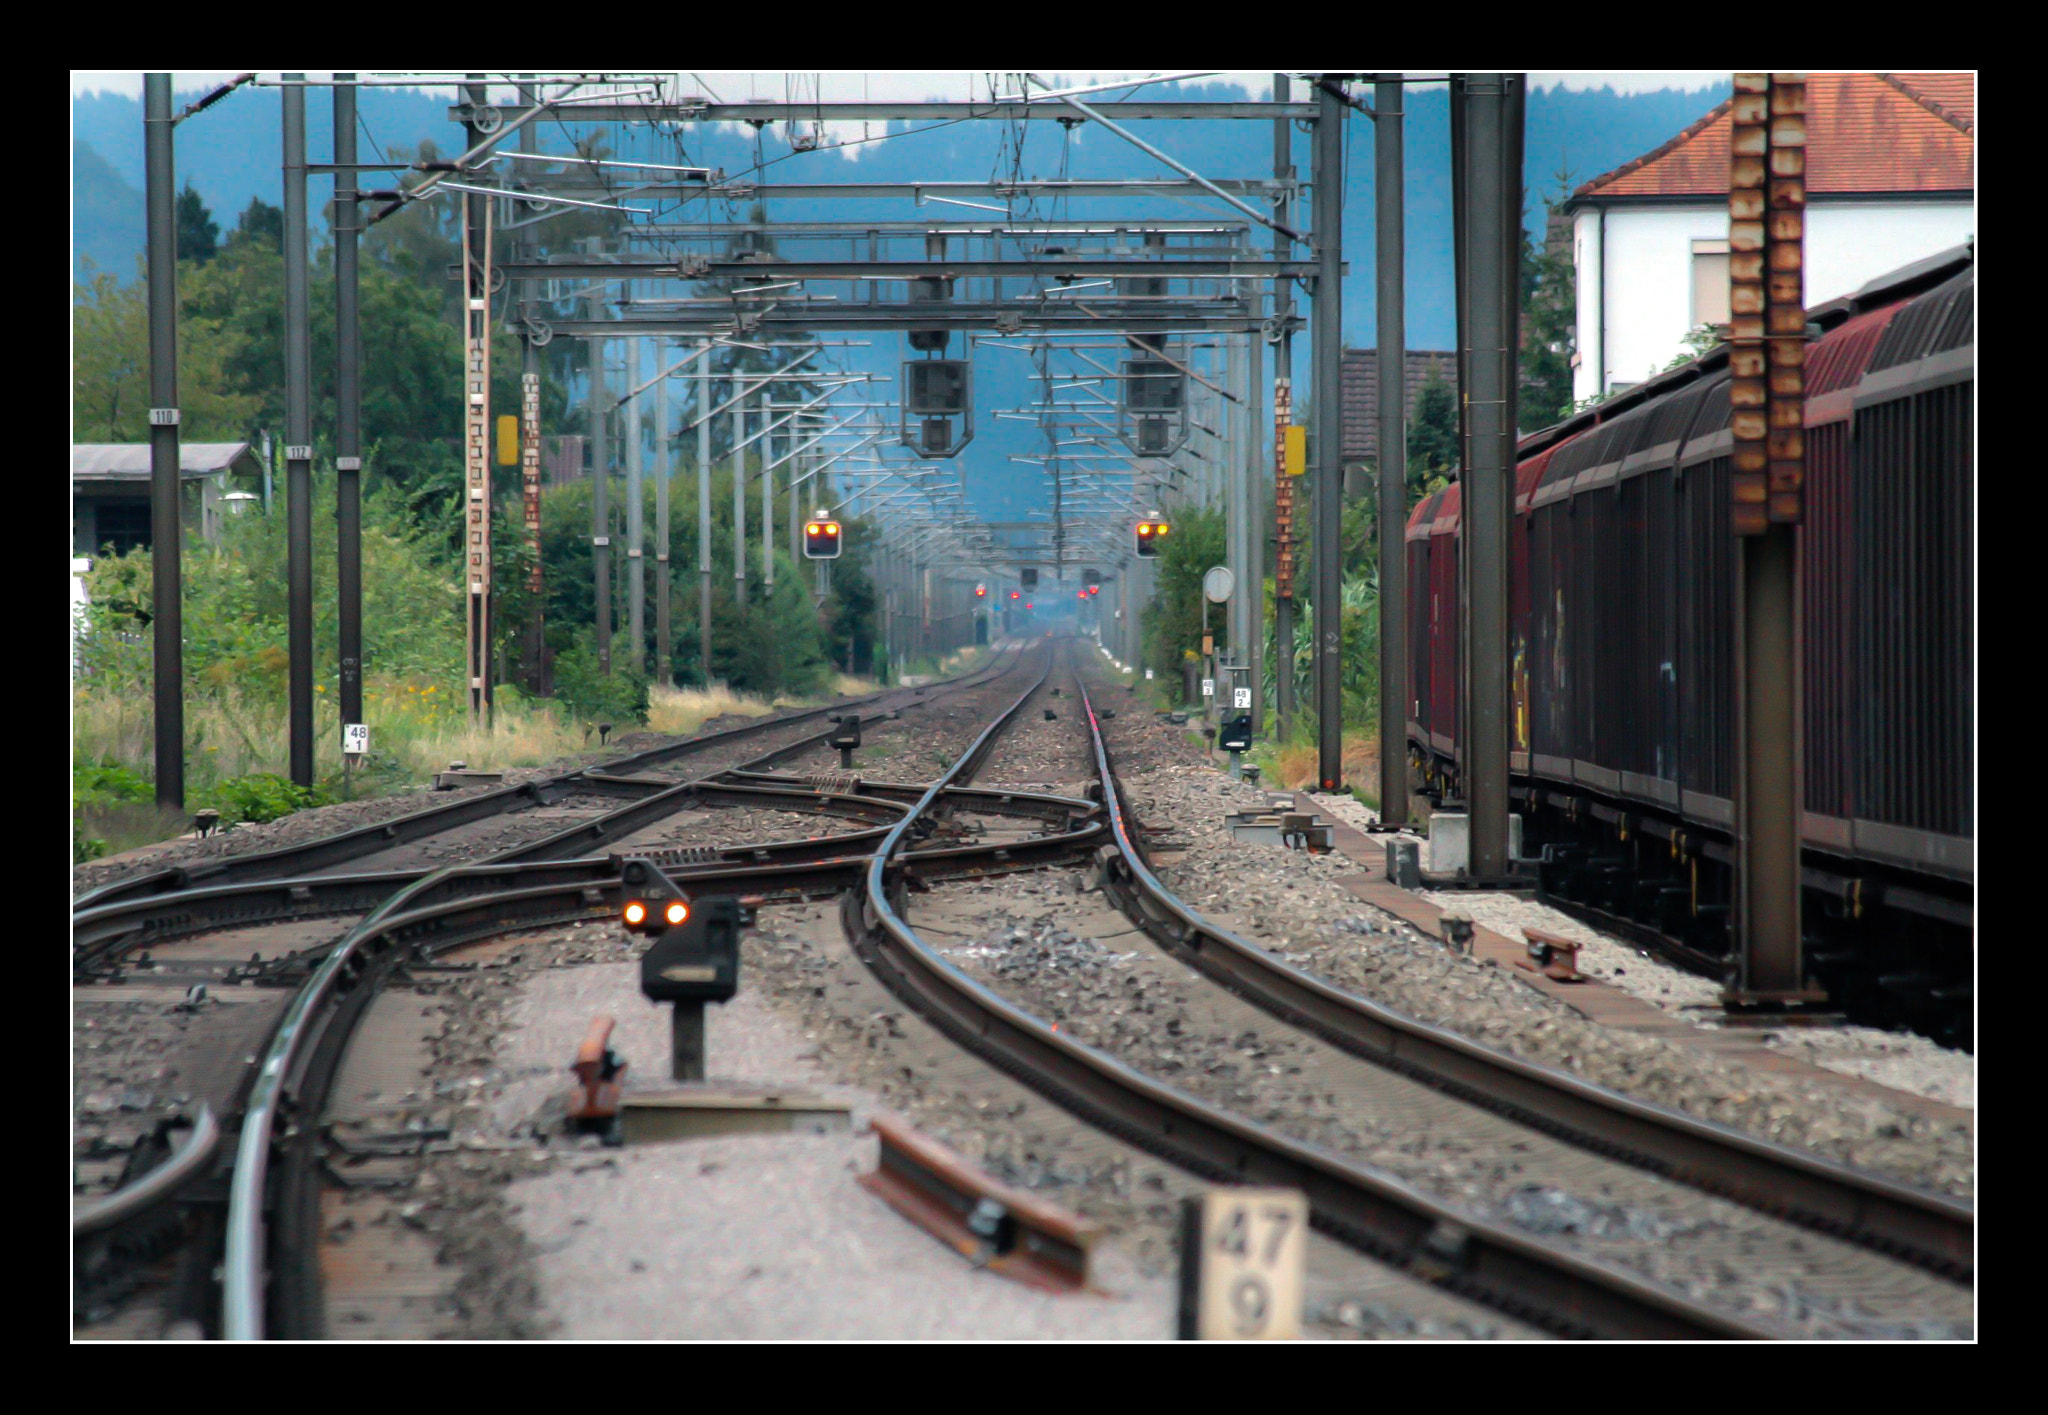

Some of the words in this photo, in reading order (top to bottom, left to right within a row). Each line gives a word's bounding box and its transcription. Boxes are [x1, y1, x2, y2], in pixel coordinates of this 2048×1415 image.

[156, 410, 172, 424] 110
[291, 446, 306, 459] 112
[1235, 690, 1247, 698] 48
[1238, 698, 1244, 707] 2
[350, 727, 367, 739] 48
[355, 740, 362, 751] 1
[1214, 1206, 1292, 1267] 47
[1231, 1272, 1272, 1336] 9
